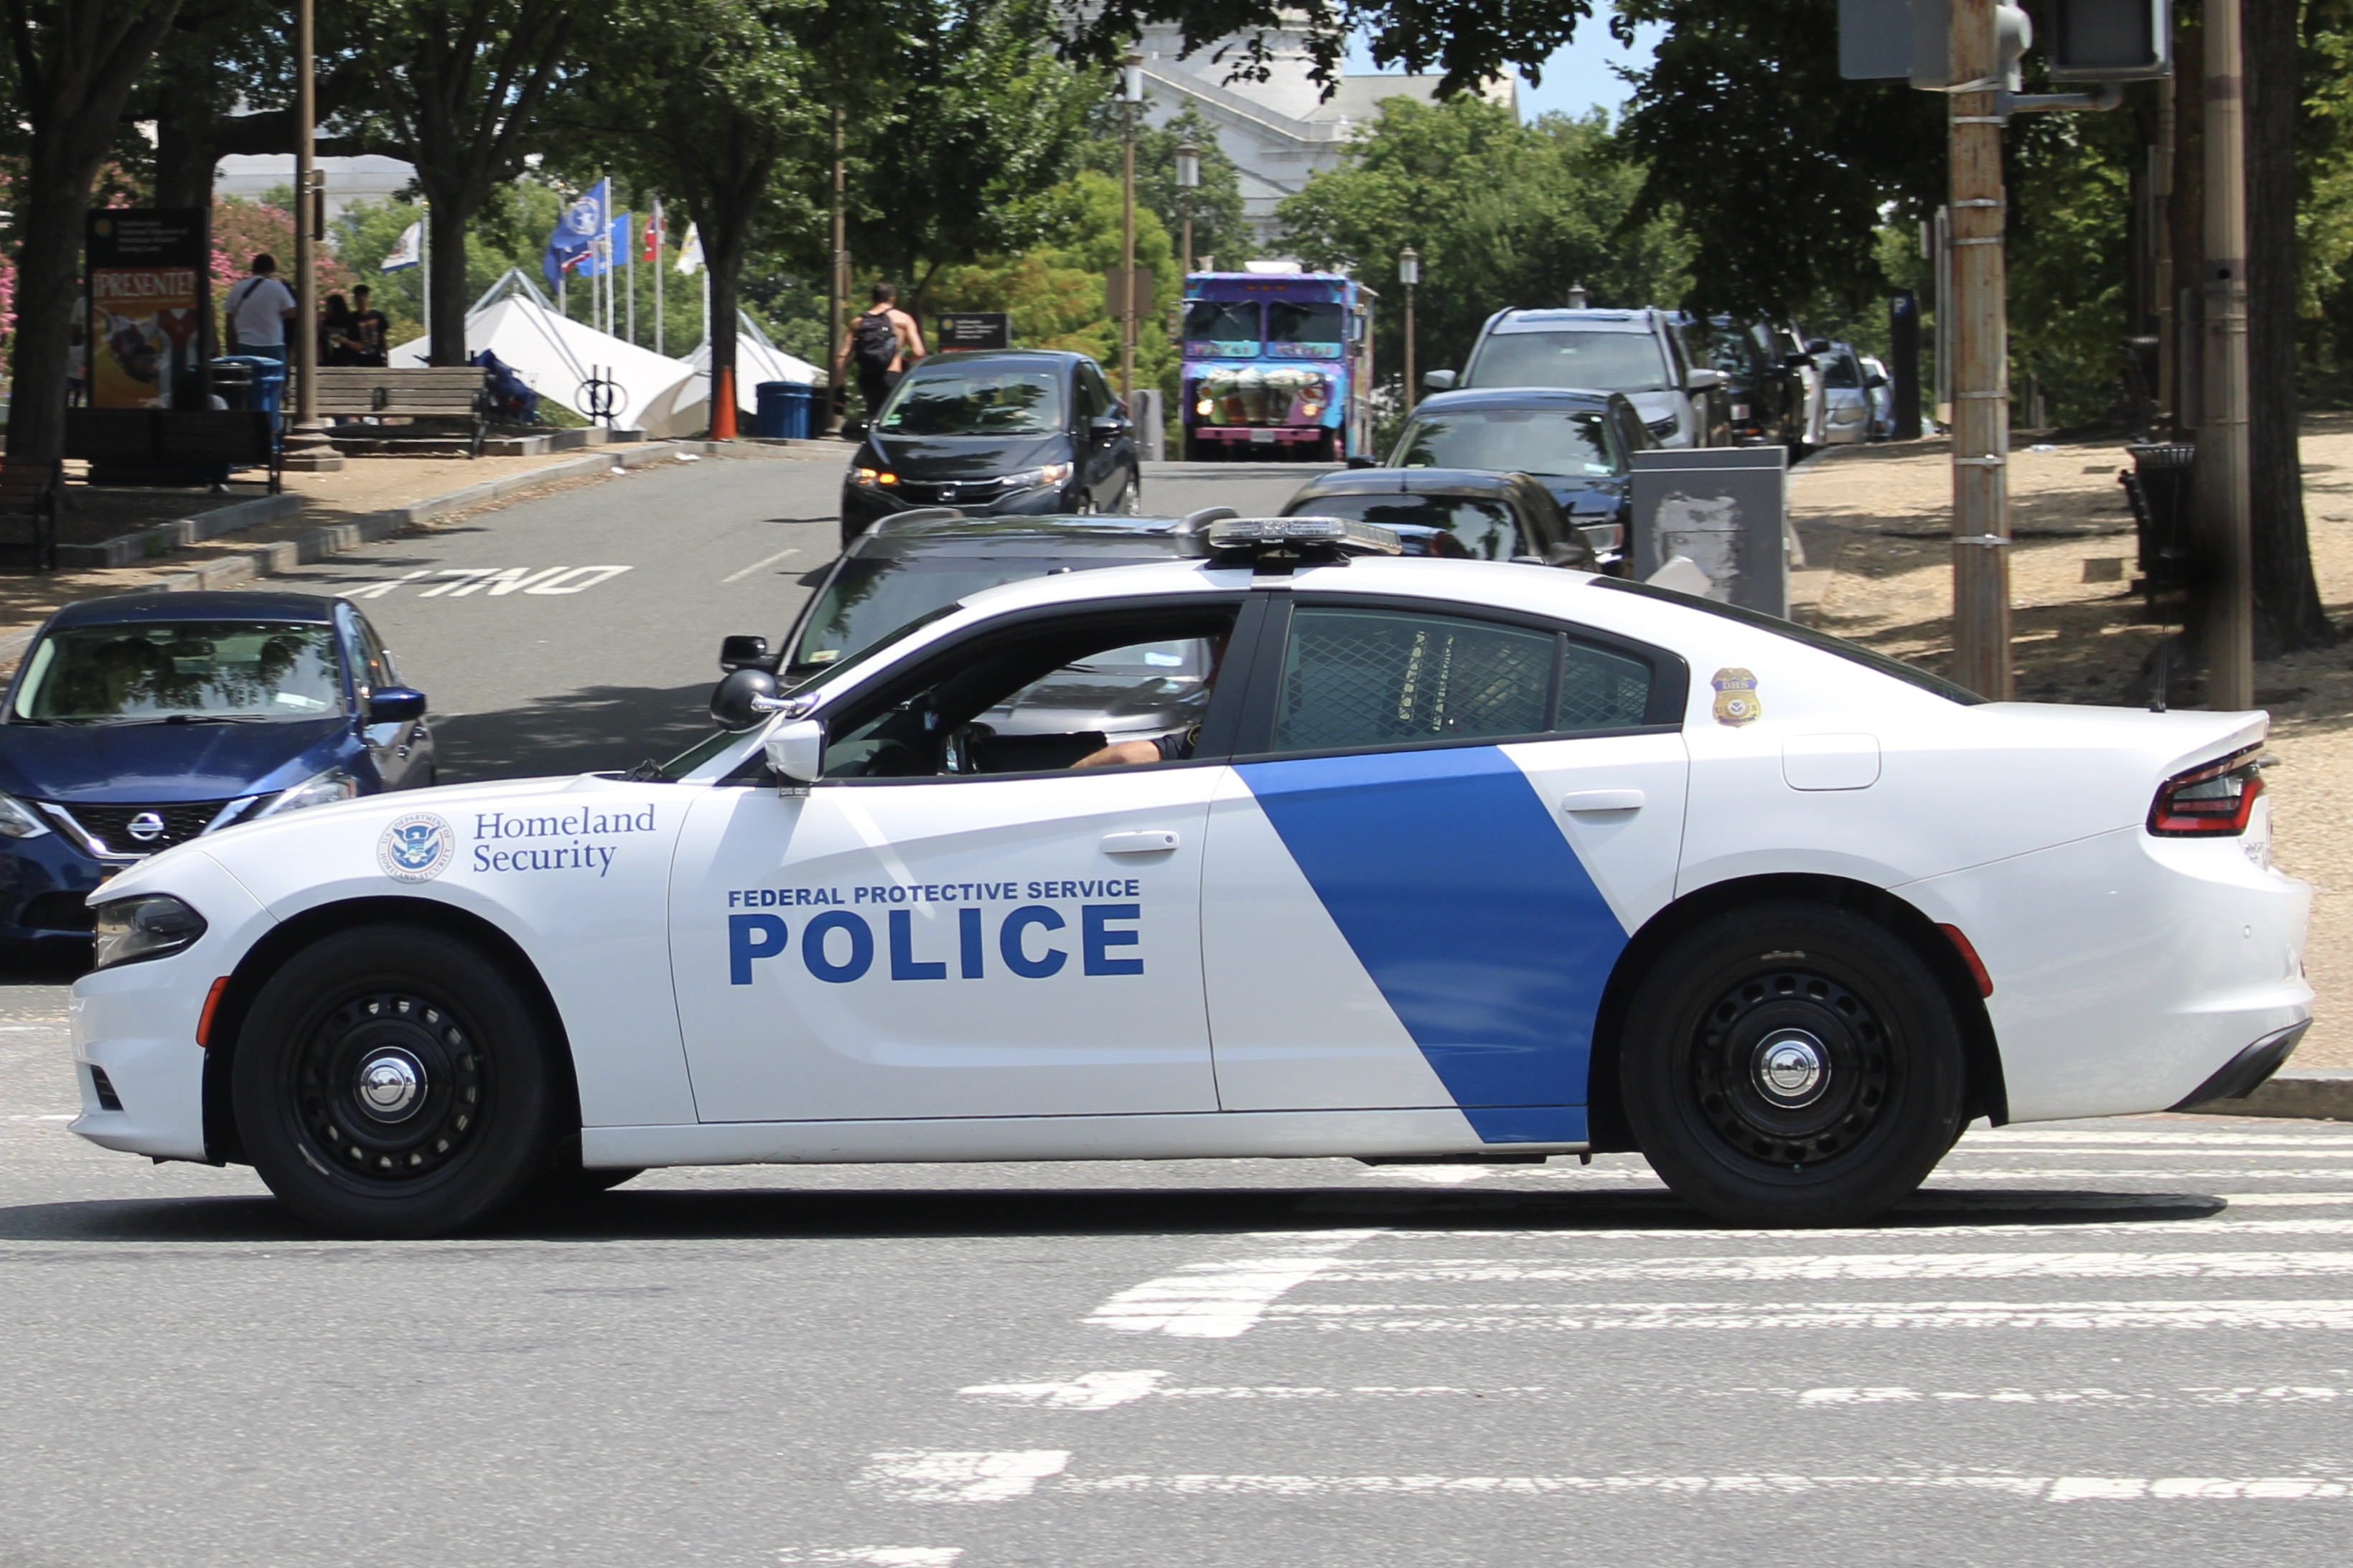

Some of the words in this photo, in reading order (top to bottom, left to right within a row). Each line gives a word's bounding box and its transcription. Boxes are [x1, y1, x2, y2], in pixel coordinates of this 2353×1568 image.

[395, 814, 446, 829] DEPARTMENT
[443, 829, 452, 839] OF
[473, 803, 657, 840] Homeland
[380, 853, 416, 881] HOMELAND
[419, 848, 451, 880] SECURITY
[474, 840, 617, 878] Security
[729, 888, 846, 907] FEDERAL
[854, 883, 1018, 904] PROTECTIVE
[1027, 879, 1140, 898] SERVICE
[728, 903, 1145, 985] POLICE
